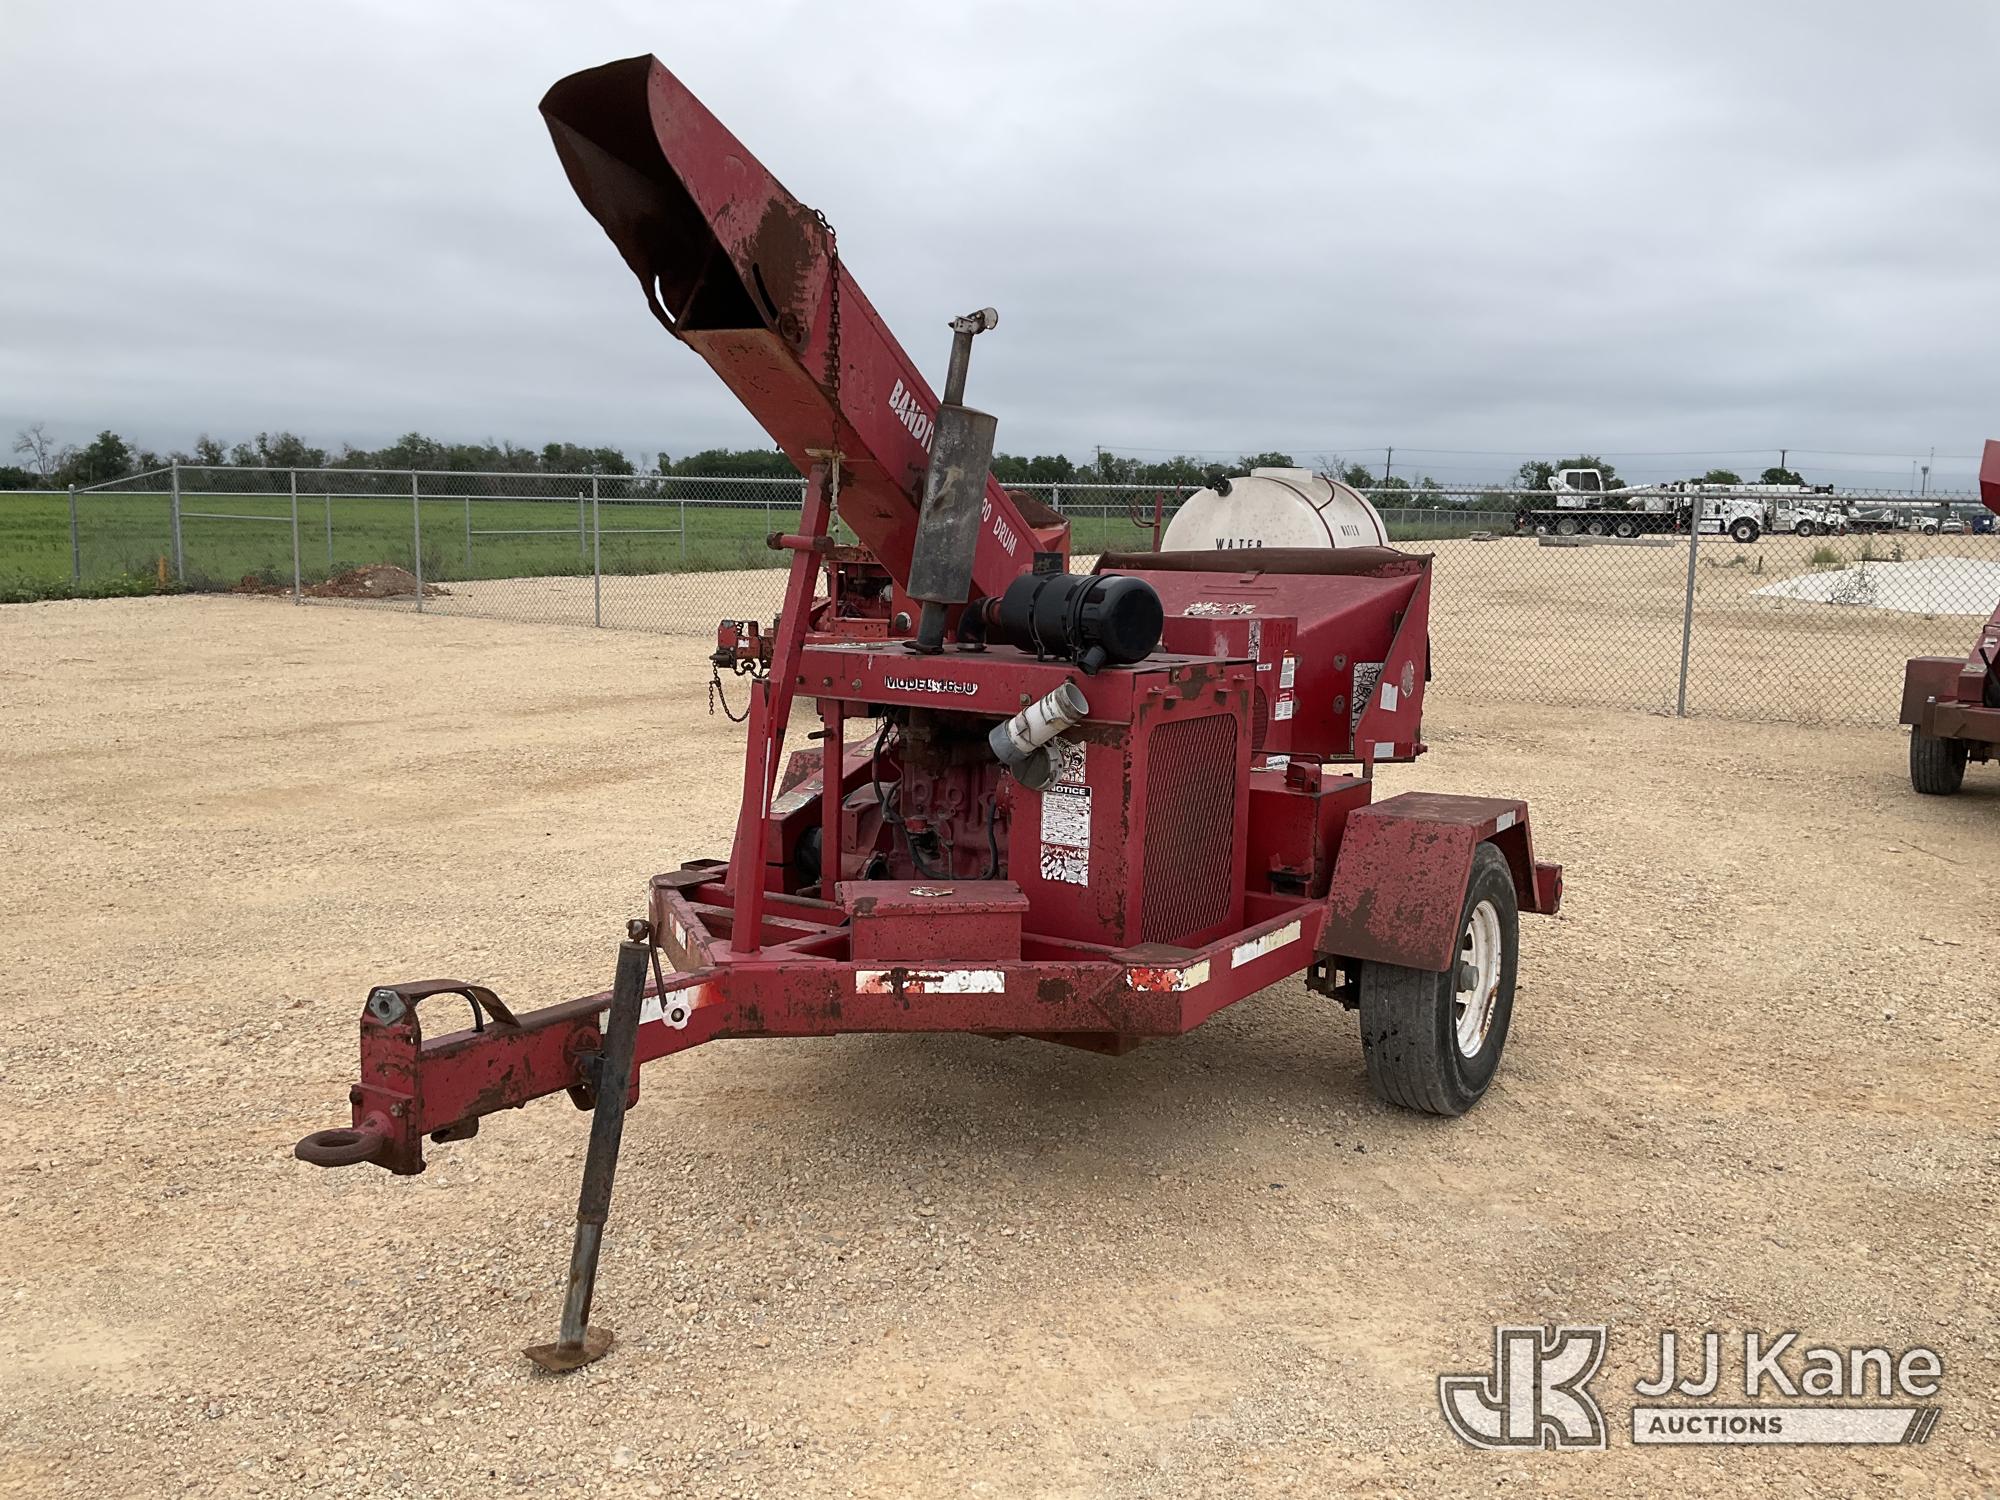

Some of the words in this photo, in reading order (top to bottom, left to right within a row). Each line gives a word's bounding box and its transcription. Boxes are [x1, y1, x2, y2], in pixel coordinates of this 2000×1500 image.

[993, 515, 1018, 557] DRUM
[1215, 538, 1262, 550] WATER
[885, 675, 935, 693] MODEL
